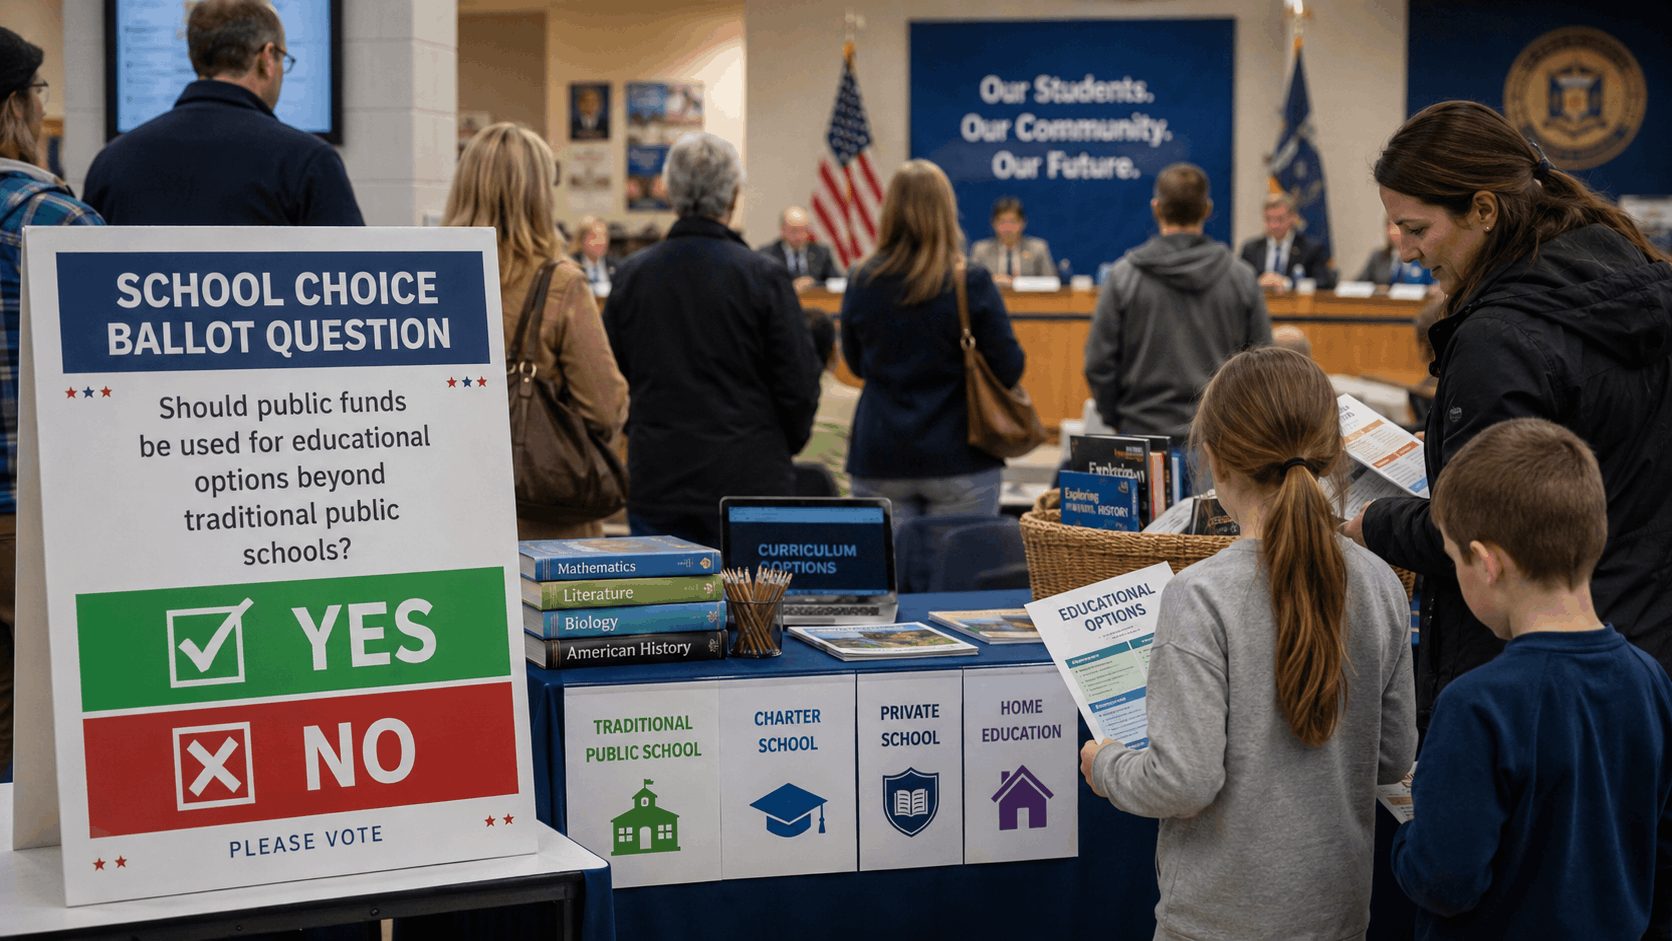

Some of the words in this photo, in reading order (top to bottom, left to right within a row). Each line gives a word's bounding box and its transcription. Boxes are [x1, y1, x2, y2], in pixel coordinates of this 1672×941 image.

[980, 75, 1028, 104] Our
[1034, 75, 1155, 104] Students.
[961, 113, 1012, 142] Our
[1015, 113, 1173, 147] Community.
[992, 151, 1041, 180] Our
[1047, 151, 1141, 180] Future.
[116, 271, 284, 309] SCHOOL
[295, 271, 439, 306] CHOICE
[107, 320, 254, 356] BALLOT
[266, 317, 451, 358] QUESTION
[159, 393, 248, 420] Should
[257, 391, 333, 422] public
[339, 389, 407, 414] funds
[139, 434, 171, 458] be
[180, 430, 240, 456] used
[249, 430, 284, 454] for
[292, 424, 431, 452] educational
[194, 467, 289, 497] options
[297, 462, 386, 493] beyond
[183, 502, 318, 532] traditional
[325, 498, 400, 528] public
[243, 537, 352, 566] schools?
[758, 543, 857, 557] CURRICULUM
[557, 560, 636, 575] Mathematics
[563, 587, 634, 603] Literature
[1058, 583, 1156, 621] EDUCATIONAL
[565, 615, 619, 632] Biology
[1084, 603, 1147, 632] OPTIONS
[290, 597, 437, 671] YES
[566, 643, 636, 660] American
[640, 641, 692, 657] History
[754, 708, 821, 727] CHARTER
[880, 703, 940, 721] PRIVATE
[1000, 699, 1043, 716] HOME
[593, 715, 693, 735] TRADITIONAL
[881, 730, 941, 747] SCHOOL
[982, 724, 1062, 743] EDUCATION
[303, 717, 416, 791] NO
[586, 745, 639, 763] PUBLIC
[642, 741, 702, 760] SCHOOL
[758, 735, 819, 754] SCHOOL
[229, 832, 316, 859] PLEASE
[325, 825, 383, 847] VOTE
